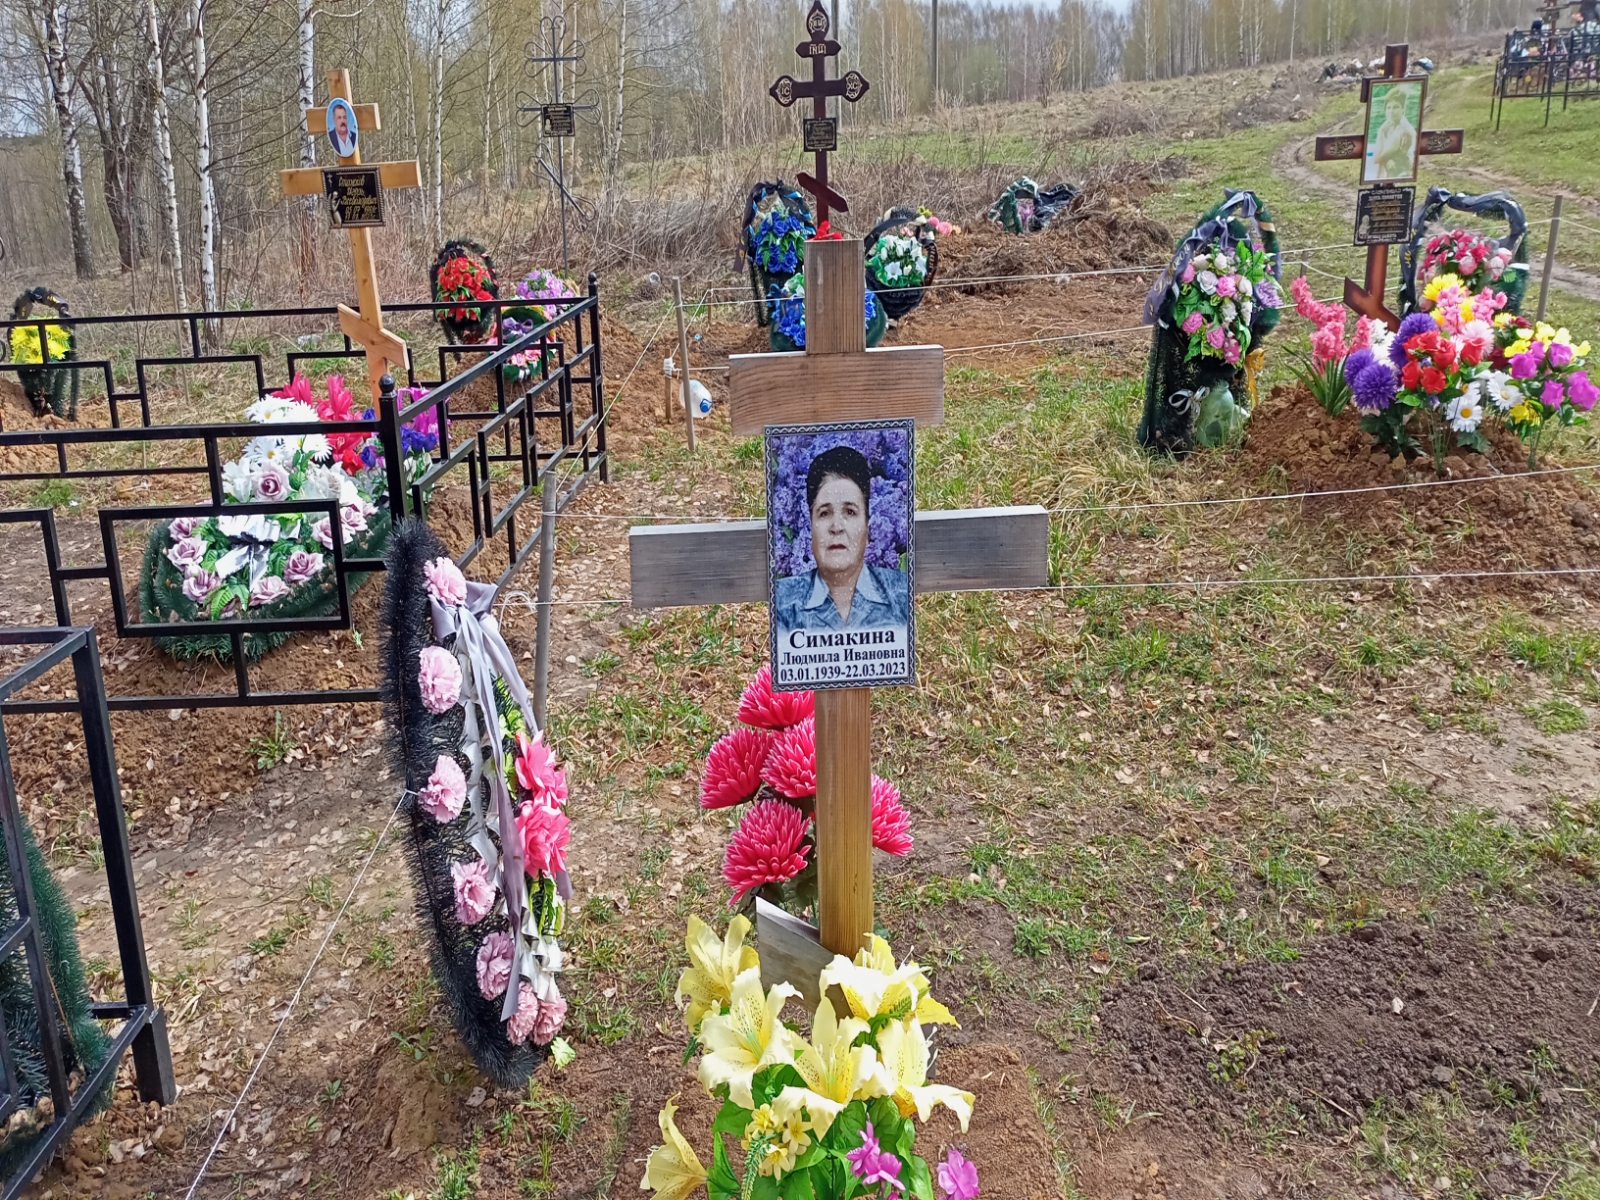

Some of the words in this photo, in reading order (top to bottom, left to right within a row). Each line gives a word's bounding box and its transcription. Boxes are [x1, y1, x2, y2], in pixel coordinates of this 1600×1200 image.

[789, 629, 896, 649] Симакина
[780, 651, 840, 666] Людмила
[843, 648, 906, 662] Ивановна
[780, 661, 906, 681] 03.01.1939-22.03.2023
